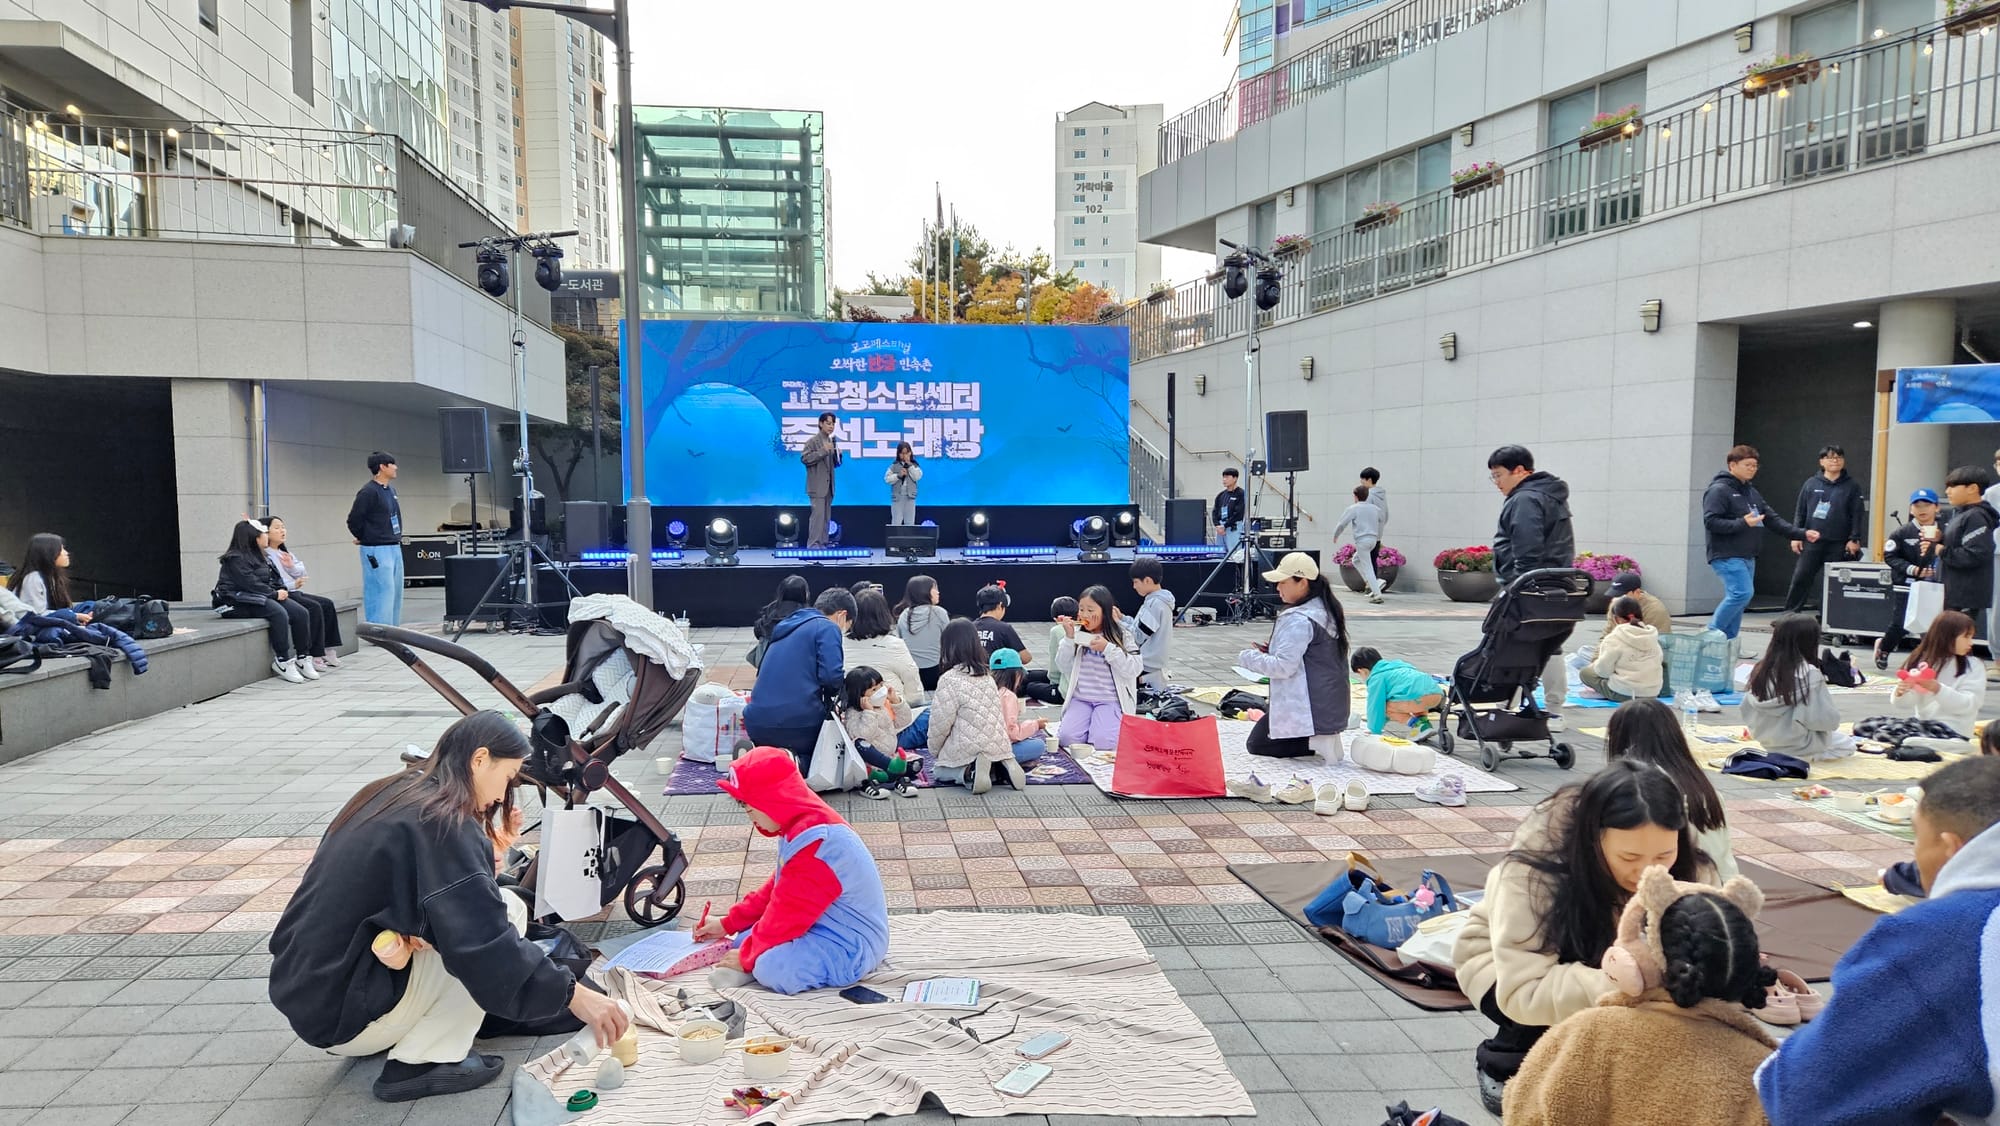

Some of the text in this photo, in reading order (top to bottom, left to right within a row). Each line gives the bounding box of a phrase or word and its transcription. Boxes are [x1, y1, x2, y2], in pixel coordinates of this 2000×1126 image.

[1076, 180, 1114, 192] 가락마을
[1086, 204, 1103, 214] 102
[567, 278, 604, 291] 도서관
[830, 357, 867, 372] 오싹한
[899, 356, 933, 372] 민속촌
[781, 380, 980, 411] 고운청소년센터
